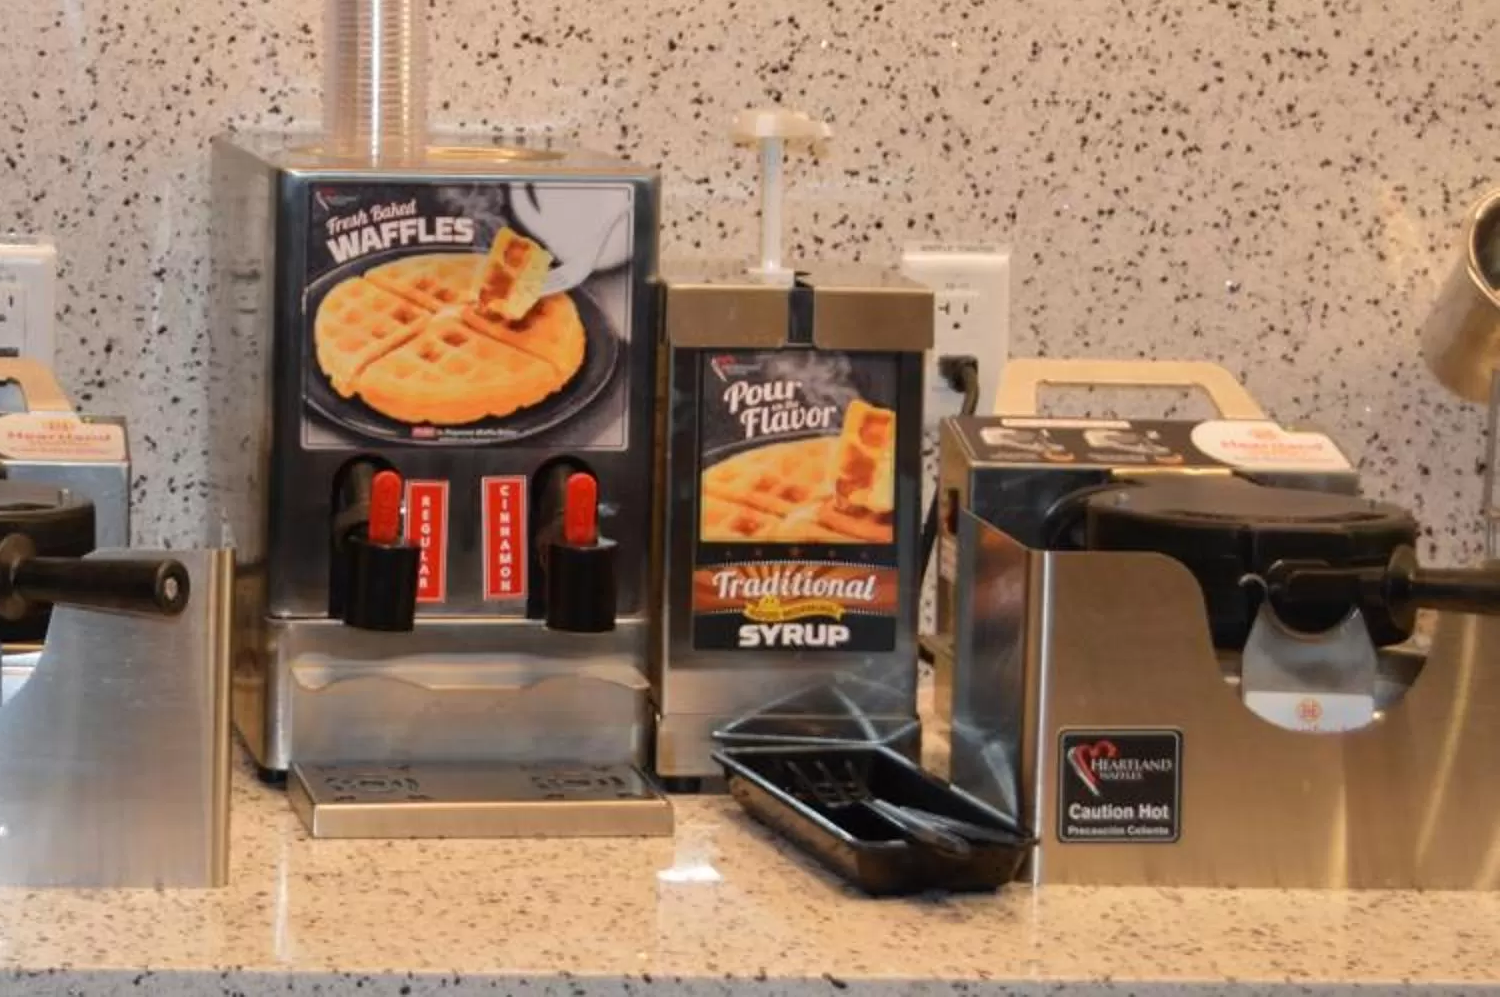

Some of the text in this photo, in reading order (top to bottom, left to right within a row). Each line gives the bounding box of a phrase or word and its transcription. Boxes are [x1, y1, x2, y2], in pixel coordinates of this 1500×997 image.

[325, 209, 368, 235] Fresh
[369, 197, 417, 223] Baked
[326, 216, 475, 265] WAFFLES
[723, 380, 803, 415] Pour
[739, 406, 837, 439] Flavor
[418, 495, 432, 589] REGULAR
[499, 484, 512, 592] CINNAMON
[711, 569, 877, 602] Traditional
[738, 623, 851, 648] SYRUP
[1068, 803, 1170, 820] Caution Hot
